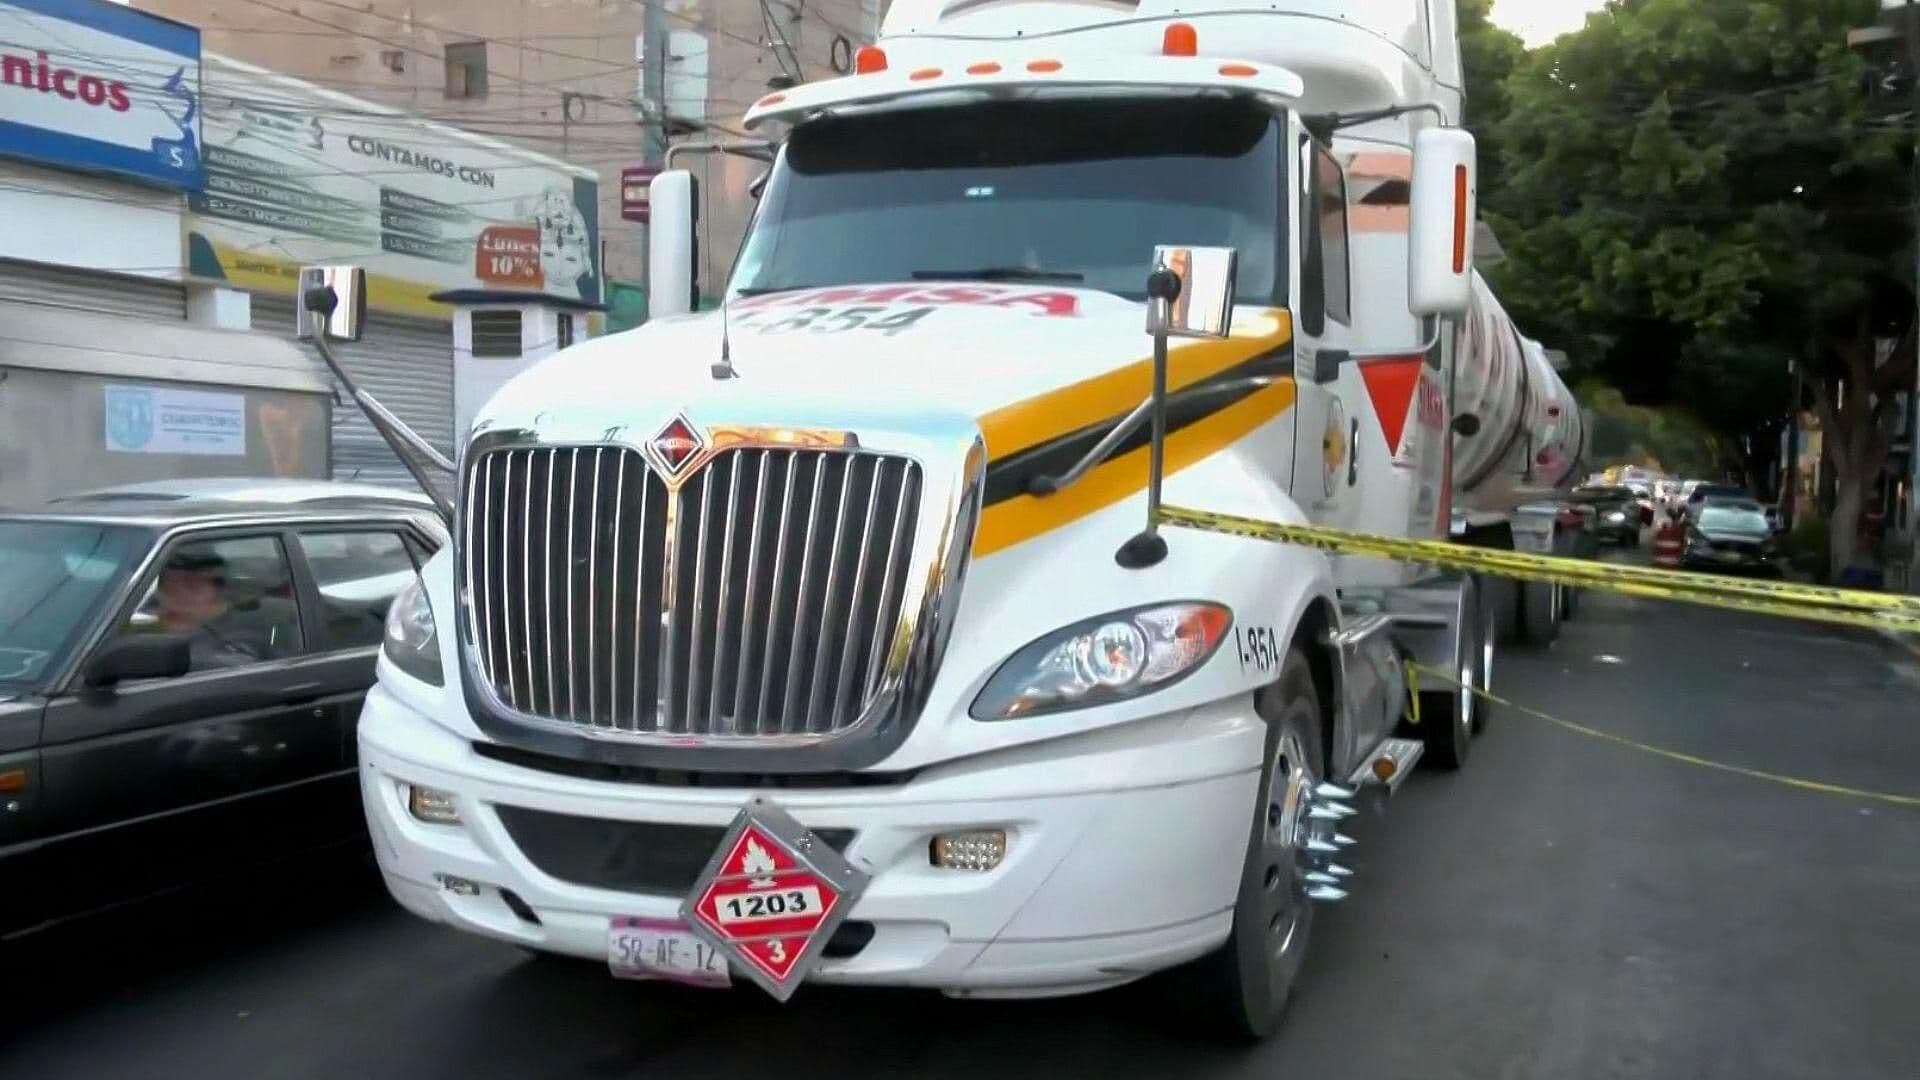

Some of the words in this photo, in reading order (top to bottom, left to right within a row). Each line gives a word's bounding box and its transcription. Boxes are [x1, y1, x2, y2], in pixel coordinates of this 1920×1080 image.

[2, 50, 131, 113] nicos
[347, 135, 455, 178] CONTAMOS
[458, 165, 495, 189] CON
[726, 890, 808, 917] 1203
[766, 938, 787, 963] 3
